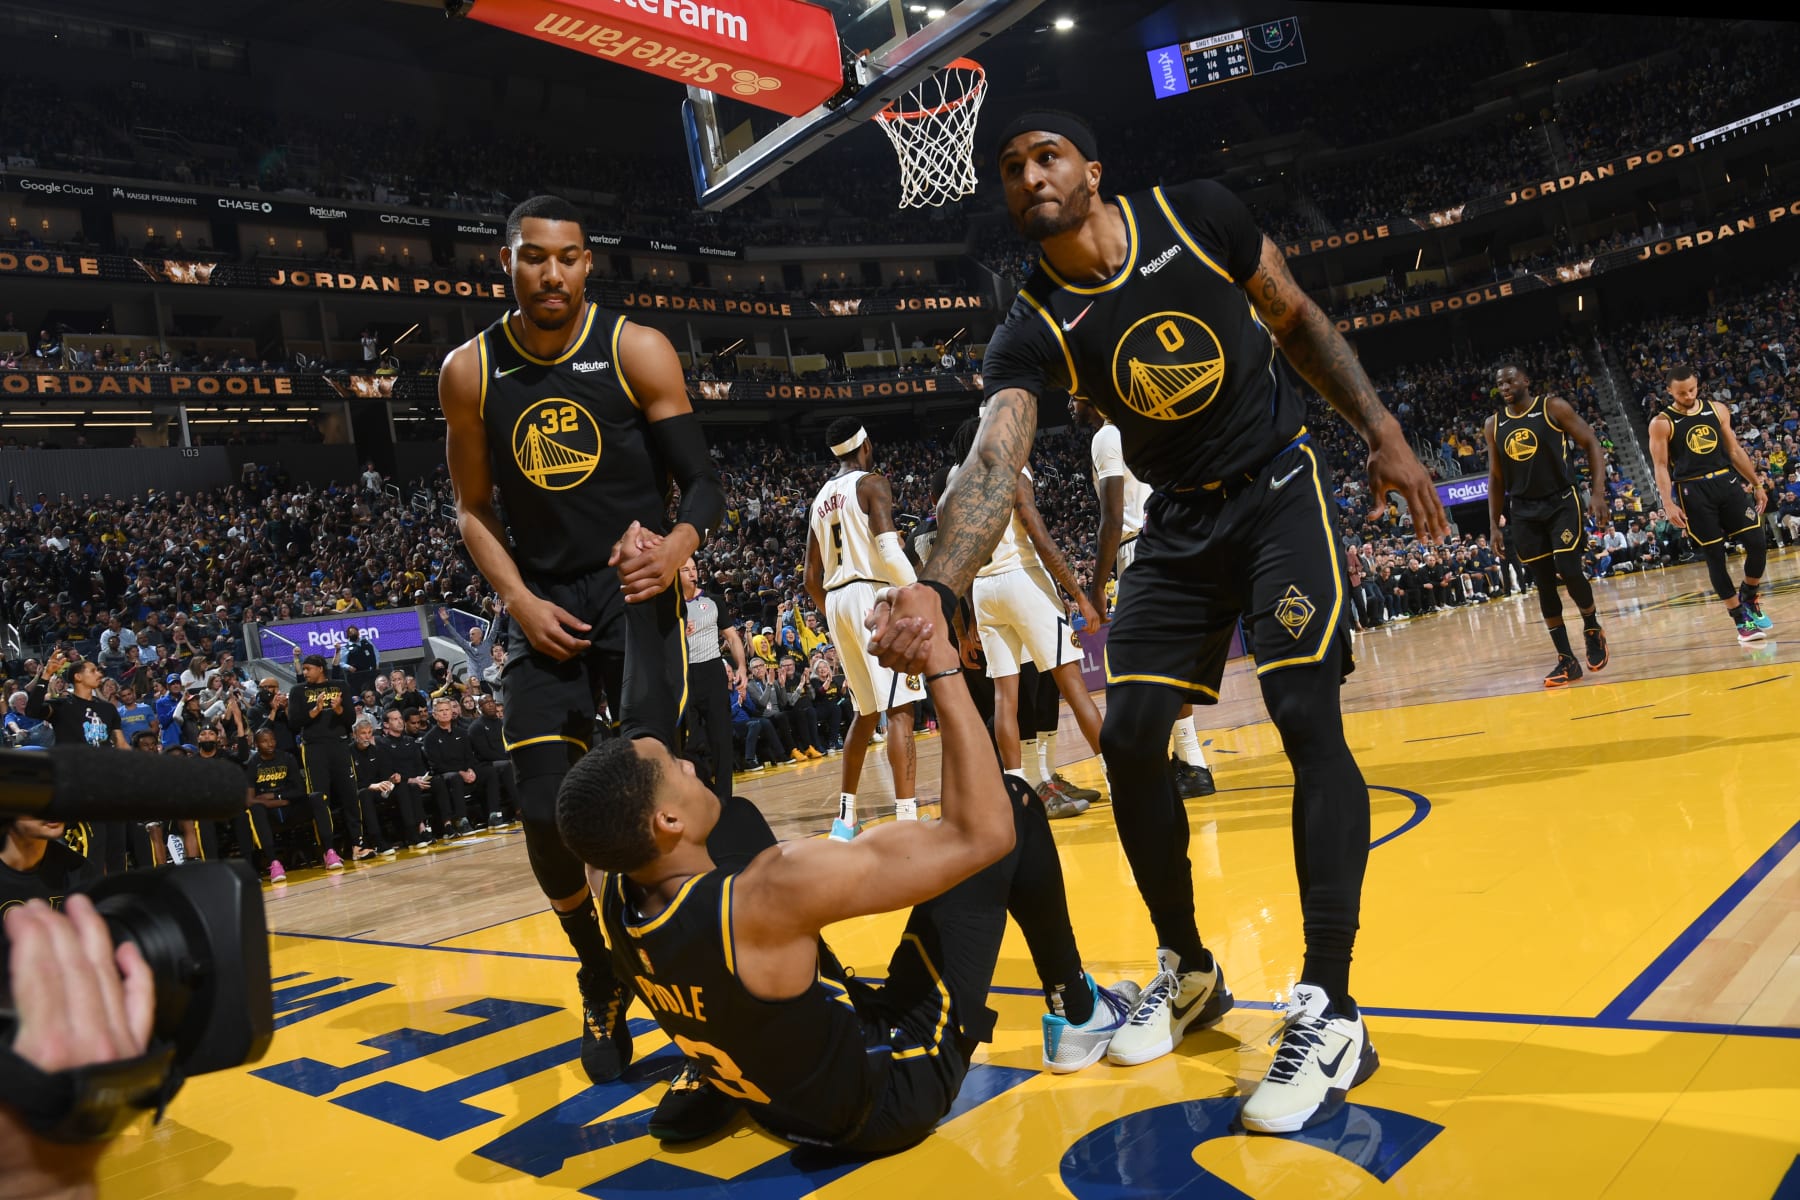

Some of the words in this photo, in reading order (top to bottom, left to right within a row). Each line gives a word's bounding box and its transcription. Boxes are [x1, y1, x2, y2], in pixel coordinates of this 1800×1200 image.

[534, 13, 733, 83] StateFarm
[1211, 33, 1235, 45] TRACKER
[1157, 52, 1177, 92] xfinity
[20, 179, 61, 194] Google
[62, 183, 94, 196] Cloud
[1504, 163, 1615, 206] JORDAN
[126, 191, 150, 202] KAISER
[151, 194, 197, 206] PERMANENTE
[218, 198, 260, 212] CHASE
[309, 206, 348, 219] Rakuten
[380, 214, 431, 227] ORACLE
[457, 222, 498, 236] accenture
[1637, 216, 1756, 261] JORDAN
[589, 235, 622, 246] verizon
[1310, 225, 1390, 253] POOLE
[699, 246, 737, 257] ticketmaster
[1139, 243, 1182, 277] Rakuten
[269, 269, 401, 292] JORDAN
[413, 278, 507, 299] POOLE
[623, 292, 717, 312] JORDAN
[724, 299, 792, 317] POOLE
[895, 295, 982, 311] JORDAN
[1430, 283, 1513, 314] POOLE
[1155, 320, 1185, 353] 0
[572, 360, 610, 373] Rakuten
[169, 376, 294, 395] POOLE
[765, 384, 853, 399] JORDAN
[862, 378, 938, 397] POOLE
[540, 405, 580, 435] 32
[1514, 430, 1530, 442] 23
[1695, 426, 1710, 437] 30
[181, 448, 200, 457] 103
[1448, 482, 1488, 501] Rakut
[308, 627, 380, 650] Rakuen
[634, 975, 708, 1023] POOLE
[673, 1034, 773, 1105] 3
